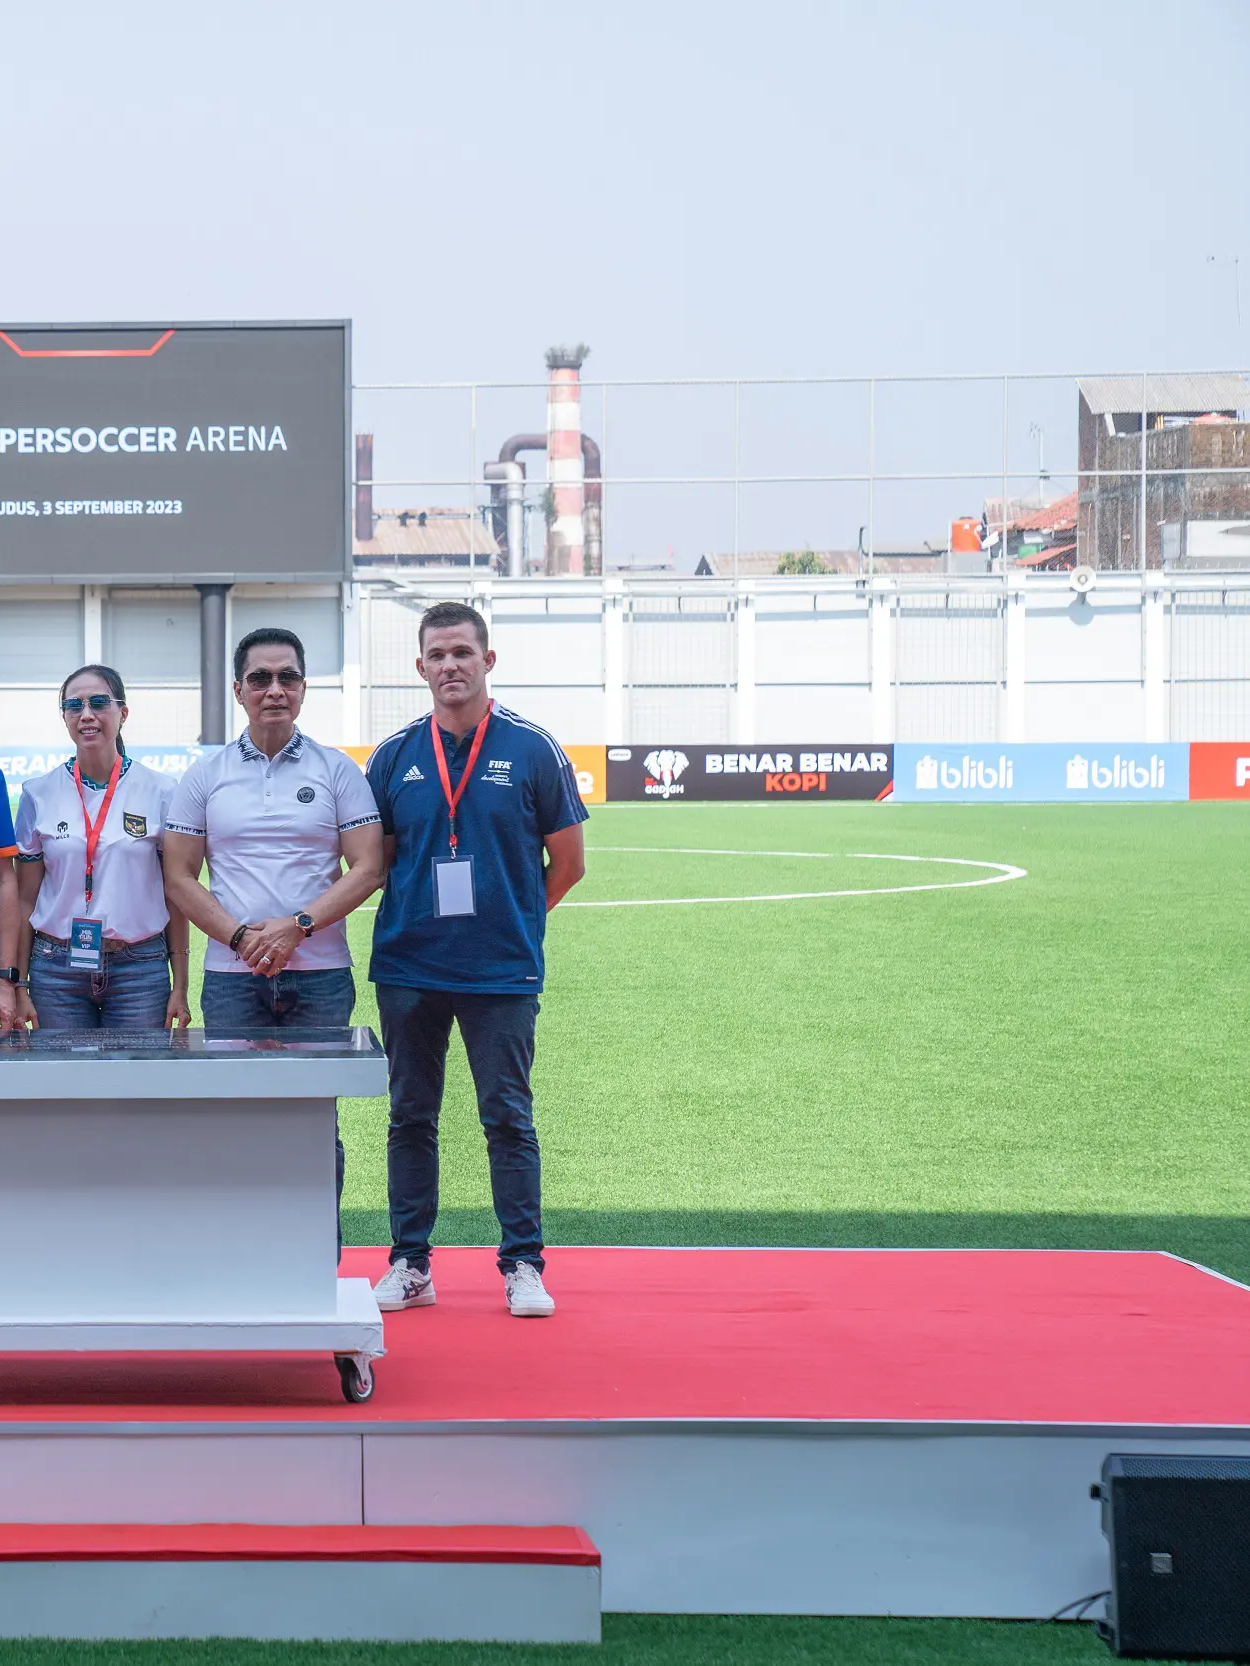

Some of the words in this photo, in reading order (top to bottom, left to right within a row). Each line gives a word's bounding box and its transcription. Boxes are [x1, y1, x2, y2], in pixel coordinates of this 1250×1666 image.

[185, 425, 288, 452] ARENA
[43, 501, 52, 515] 3
[54, 500, 142, 515] SEPTEMBER
[146, 500, 182, 514] 2023
[488, 760, 511, 769] FIFA
[705, 753, 792, 774] BENAR
[799, 752, 888, 773] BENAR
[941, 755, 1014, 789] blibli
[1091, 754, 1165, 789] blibli
[402, 774, 425, 782] adidas
[765, 773, 826, 793] KOPI
